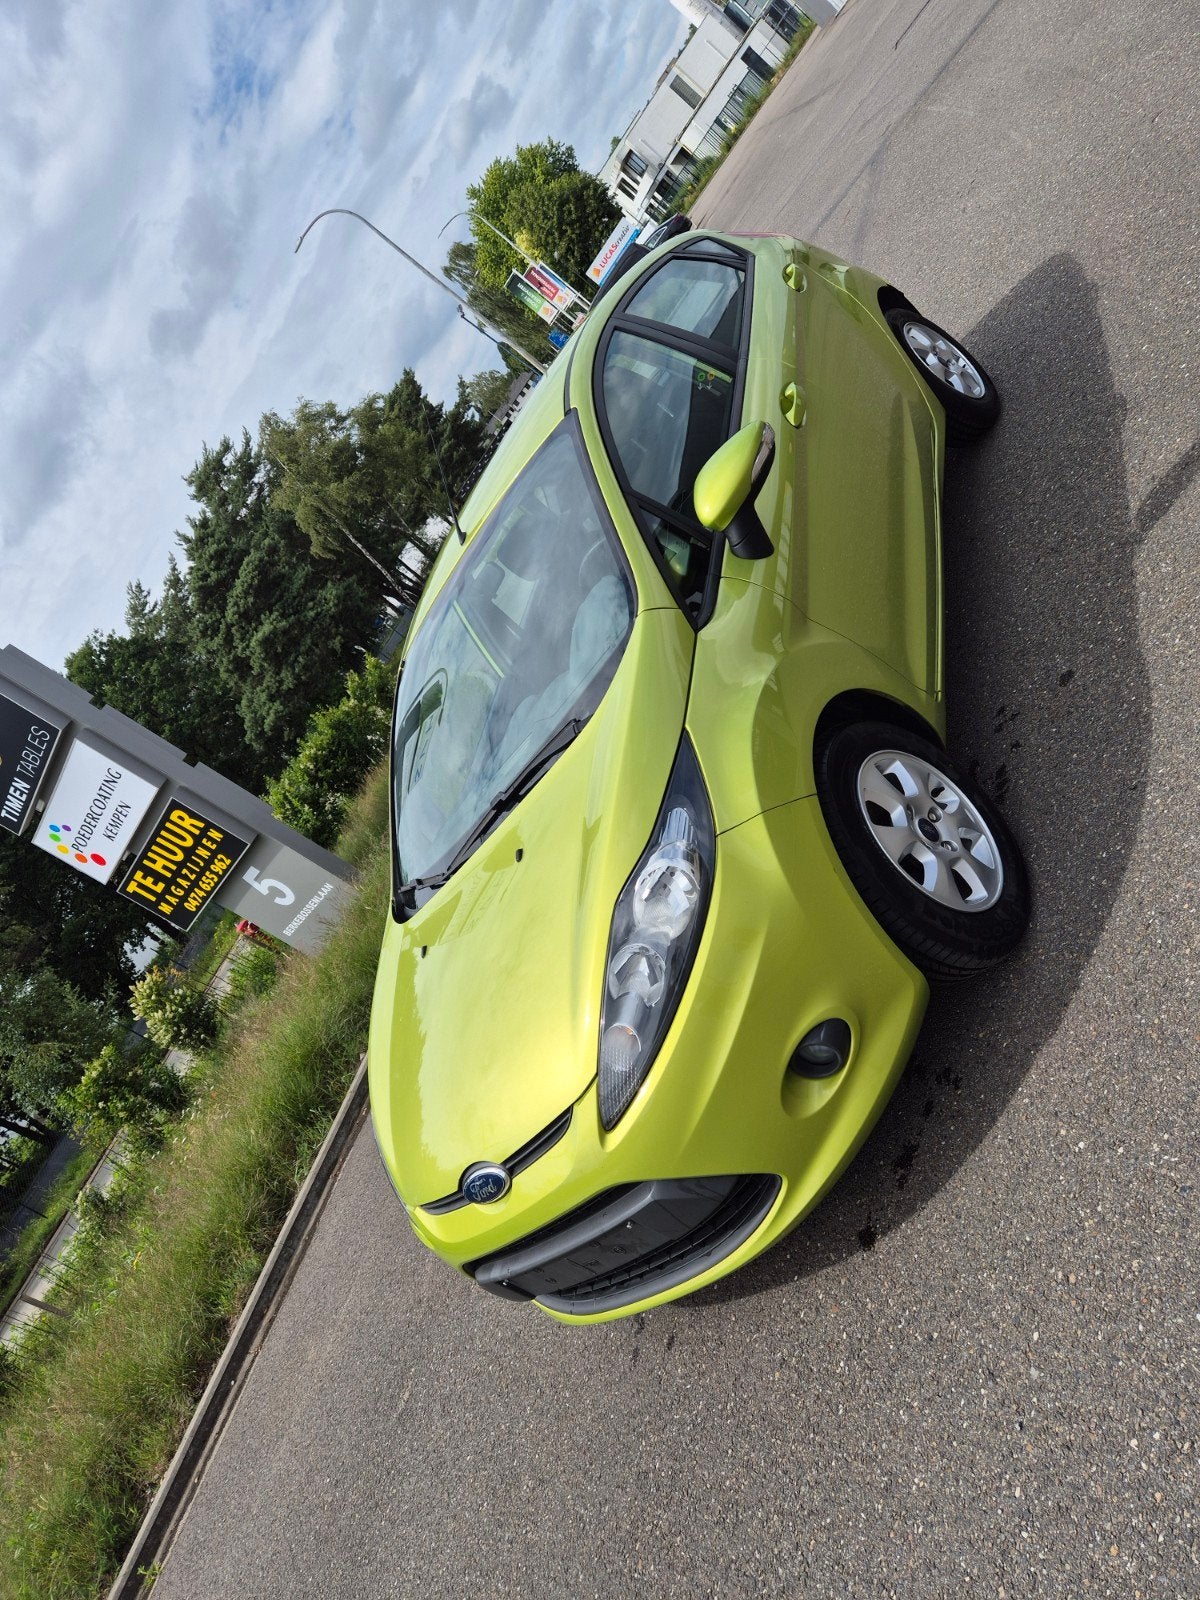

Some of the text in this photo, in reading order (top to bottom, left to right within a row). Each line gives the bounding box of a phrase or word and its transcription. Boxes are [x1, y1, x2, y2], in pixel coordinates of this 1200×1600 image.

[1, 726, 49, 822] TIMEN TABLES
[71, 768, 122, 853] POEDERCOATING
[103, 800, 131, 842] KEMPEN
[126, 809, 205, 902] TE HUUR
[158, 829, 224, 915] MAGAZIJNEN
[184, 854, 232, 911] 0474 655 962
[243, 866, 296, 906] 5
[283, 883, 334, 937] BERKEBOSSENLAAN
[470, 1178, 497, 1201] Ford
